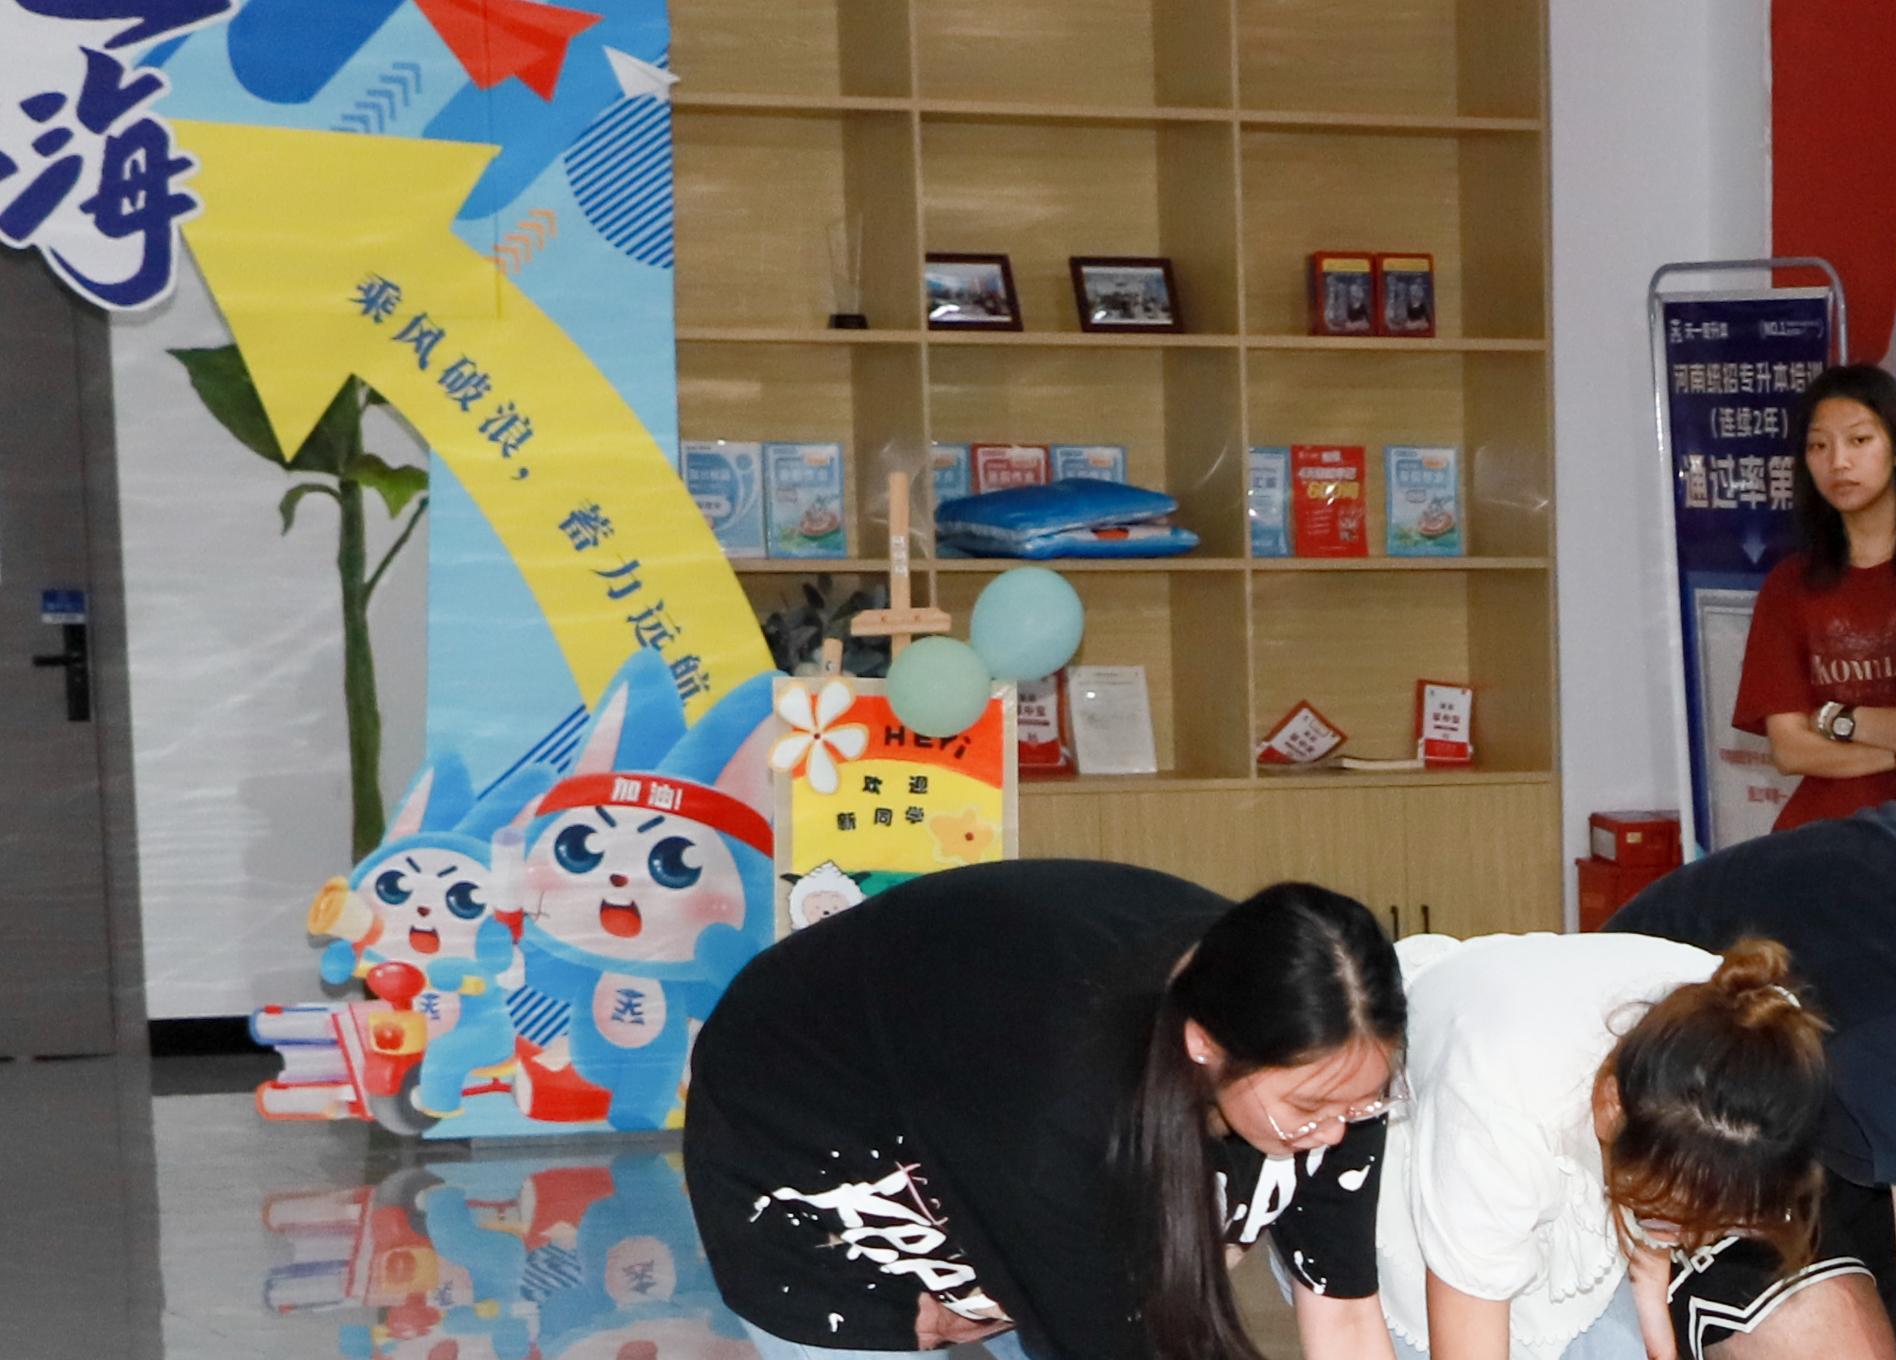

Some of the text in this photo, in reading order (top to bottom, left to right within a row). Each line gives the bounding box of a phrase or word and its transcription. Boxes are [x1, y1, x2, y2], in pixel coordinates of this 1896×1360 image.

[0, 46, 197, 306] 海
[1679, 453, 1795, 510] 通过率第
